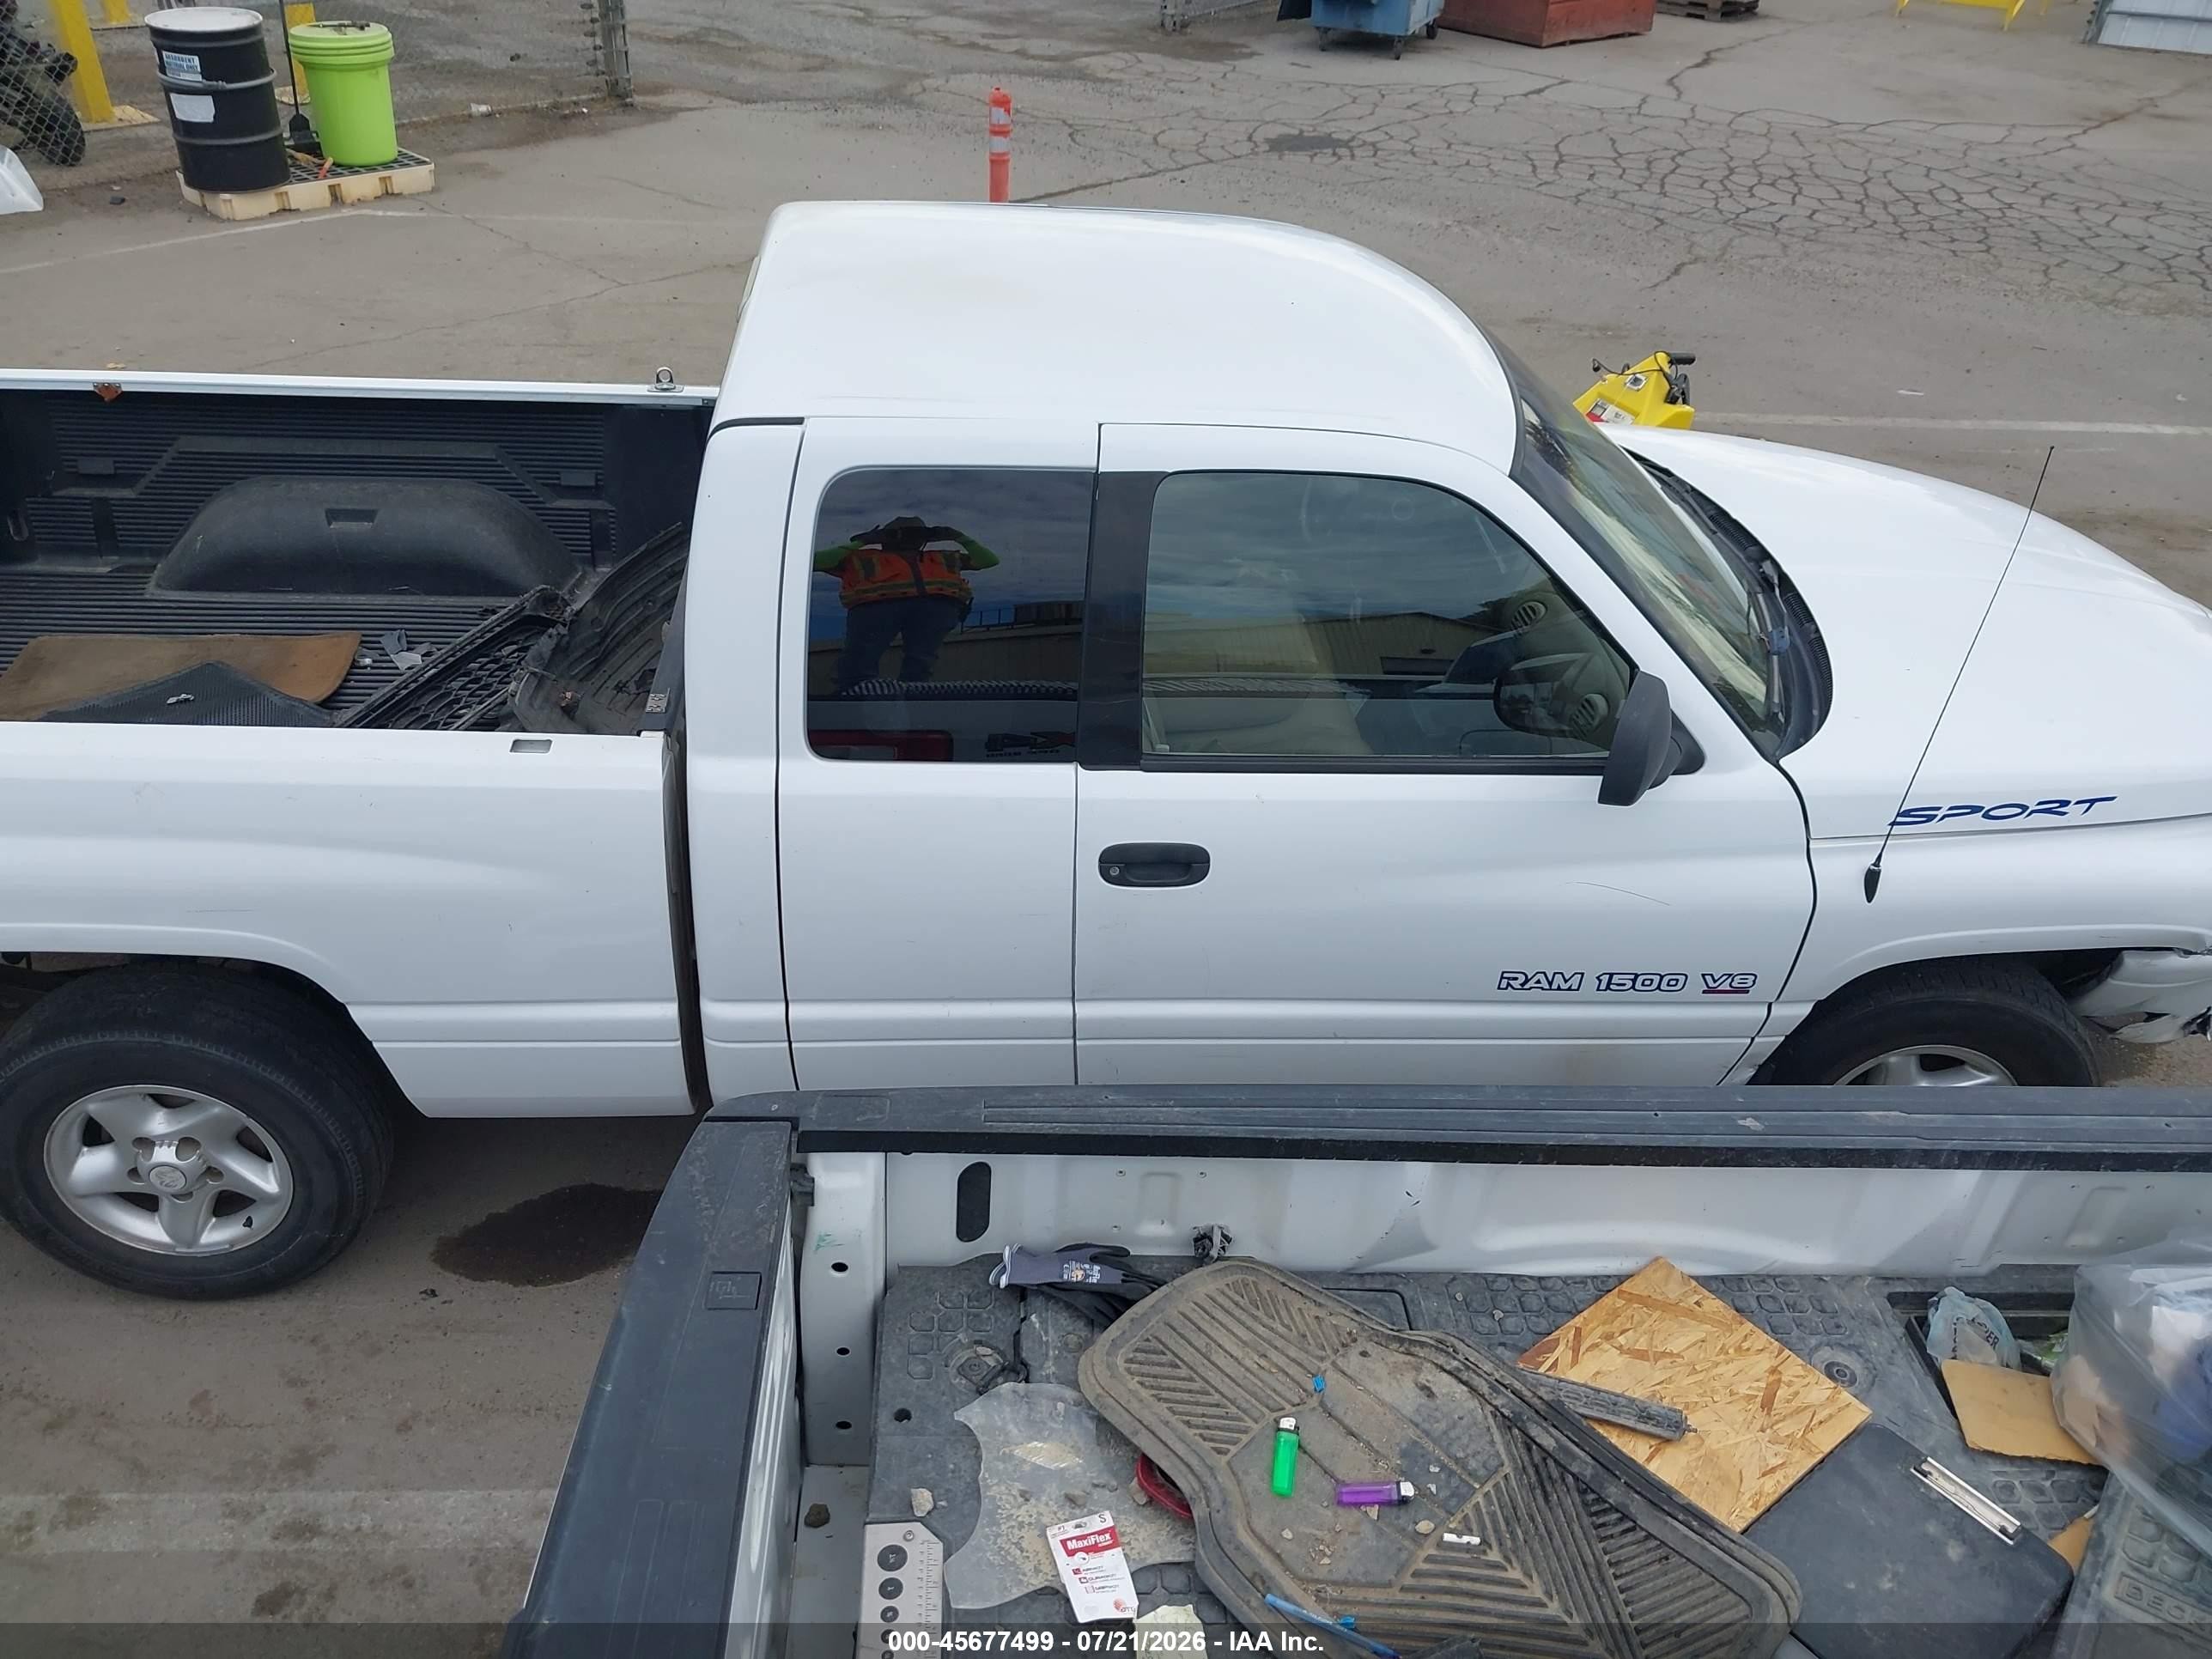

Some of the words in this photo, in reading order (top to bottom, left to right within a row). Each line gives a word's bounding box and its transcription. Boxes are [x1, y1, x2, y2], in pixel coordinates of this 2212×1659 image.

[1887, 796, 2118, 826] SPORT
[1498, 970, 1584, 992] RAM
[1595, 971, 1688, 993] 1500
[1701, 972, 1758, 989] V8
[1098, 1513, 1107, 1523] S
[1066, 1532, 1112, 1551] MaxiFlex
